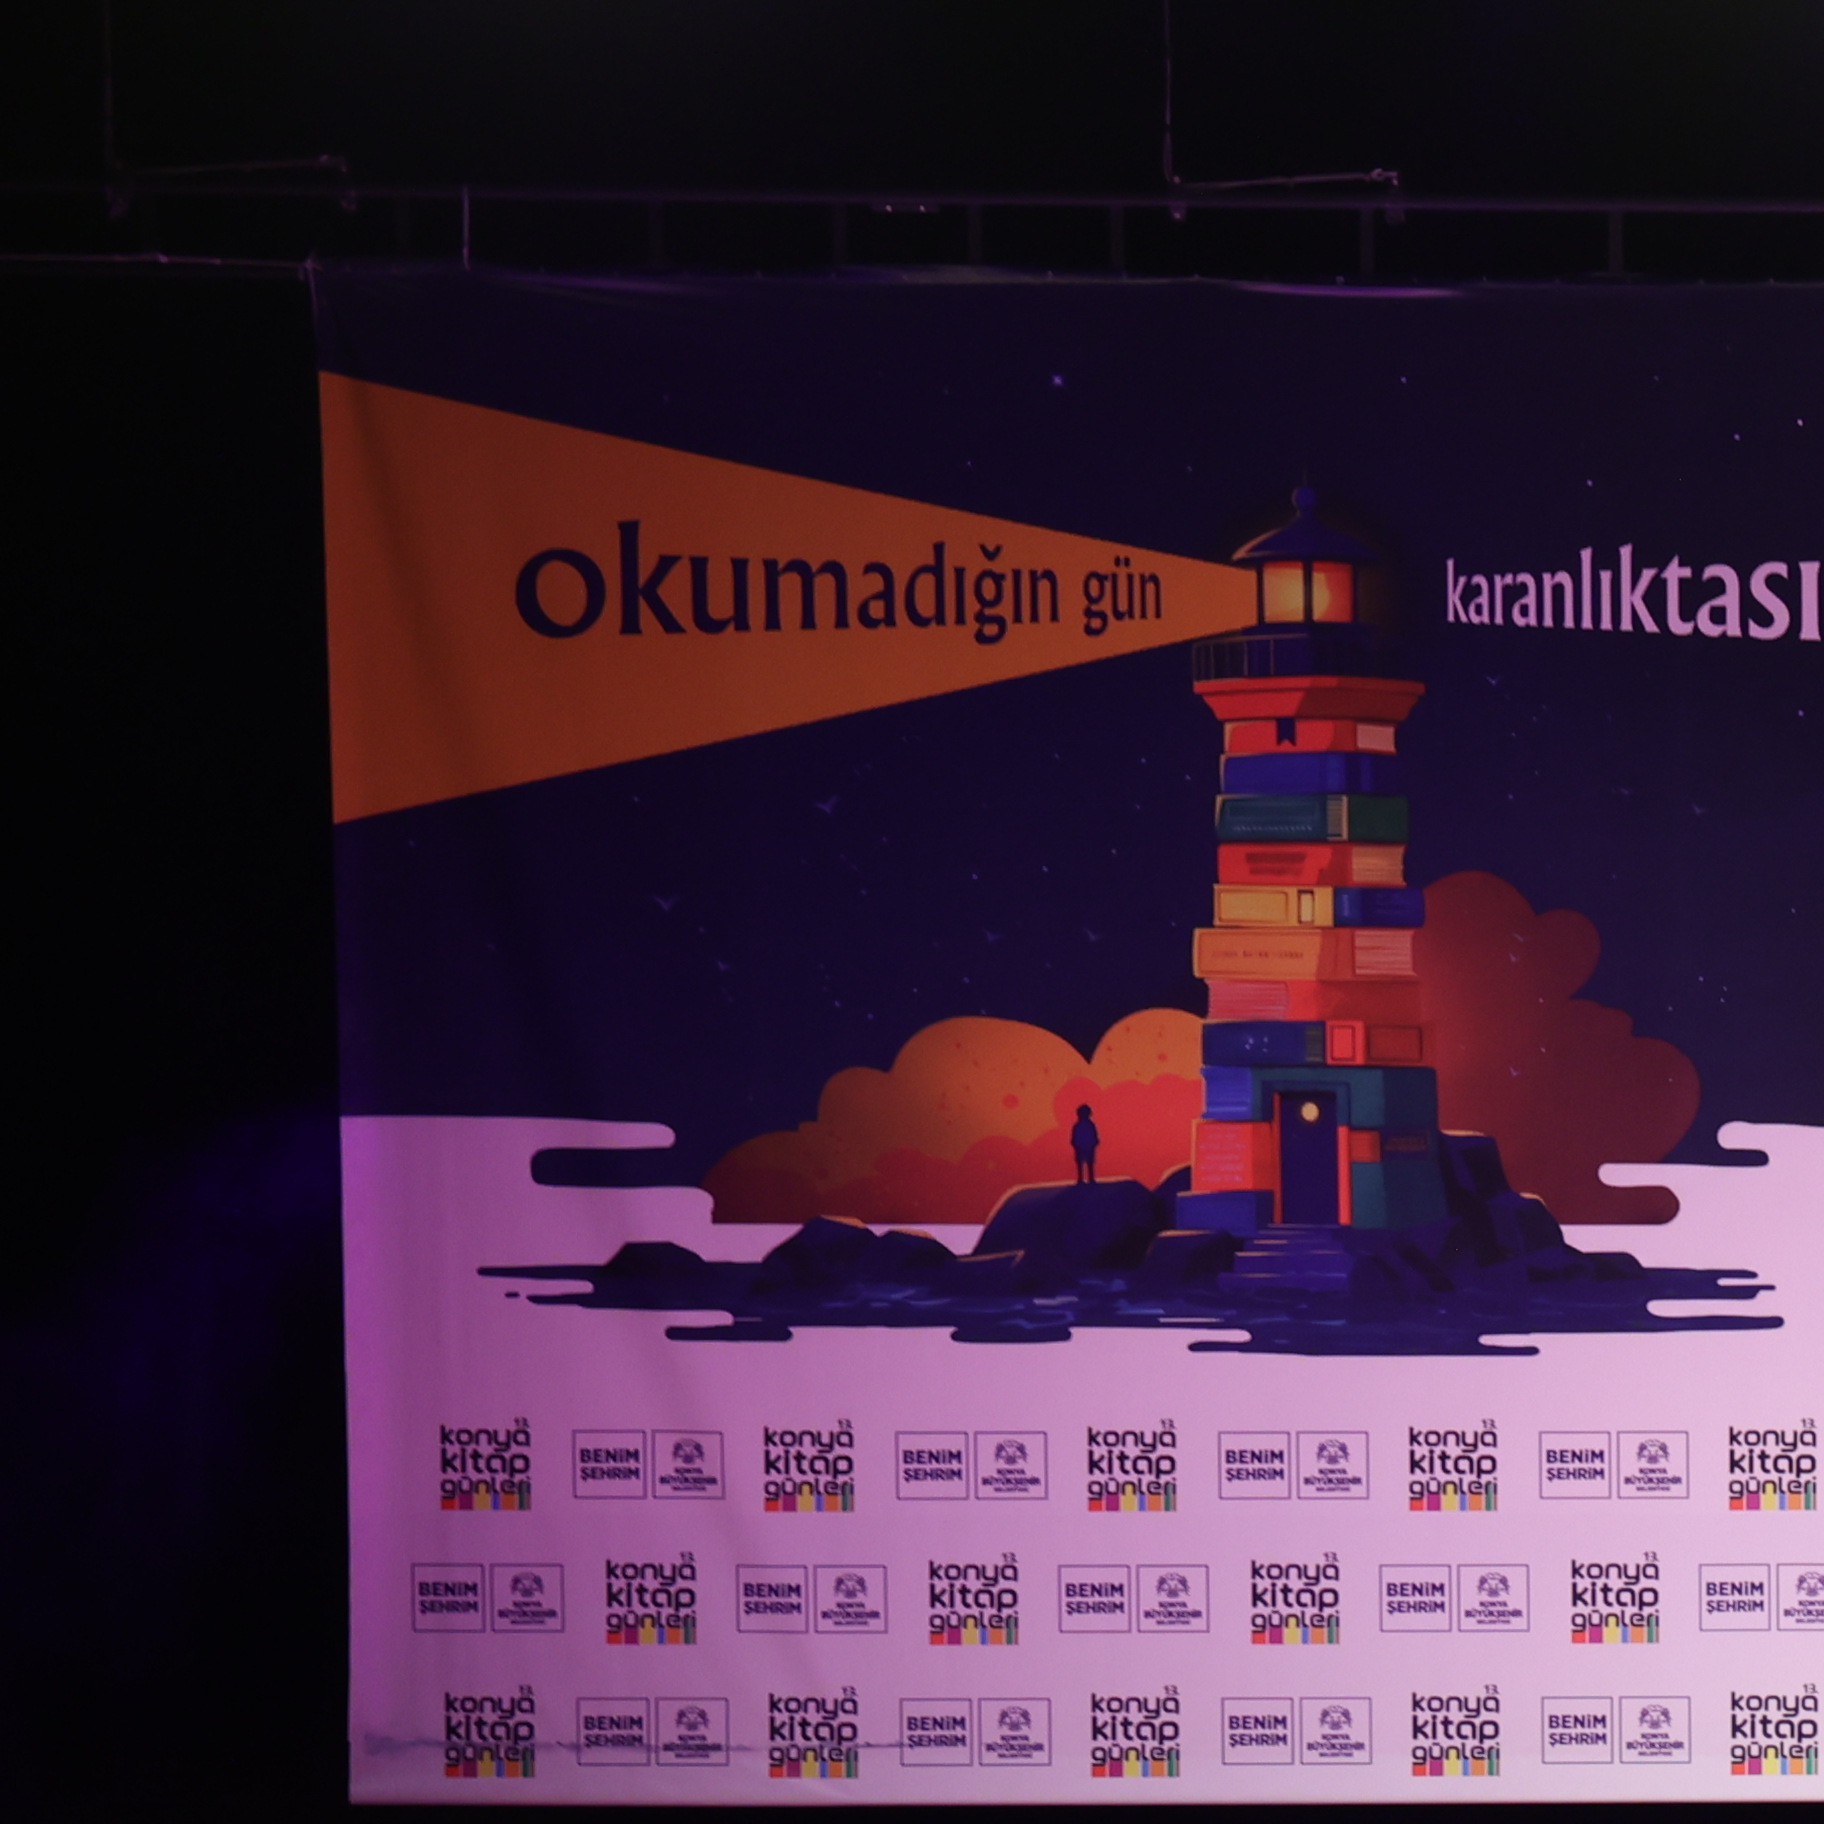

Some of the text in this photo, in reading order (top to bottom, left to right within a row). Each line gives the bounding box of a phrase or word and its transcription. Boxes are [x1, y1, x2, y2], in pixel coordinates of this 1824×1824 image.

[515, 520, 1163, 645] okumadığın gün
[442, 1425, 530, 1452] konya
[765, 1426, 854, 1453] konya
[1089, 1427, 1176, 1453] konya
[1410, 1426, 1497, 1452] konya
[1729, 1425, 1817, 1452] konya
[442, 1448, 529, 1478] kitap
[765, 1449, 853, 1480] kitap
[1089, 1449, 1175, 1480] kitap
[1410, 1448, 1496, 1479] kitap
[1729, 1448, 1816, 1478] kitap
[607, 1559, 696, 1586] konya
[1252, 1559, 1340, 1586] konya
[607, 1582, 695, 1613] kitap
[1252, 1582, 1339, 1612] kitap
[770, 1693, 858, 1720] konya
[1413, 1692, 1500, 1718] konya
[770, 1716, 857, 1746] kitap
[1413, 1714, 1499, 1745] kitap
